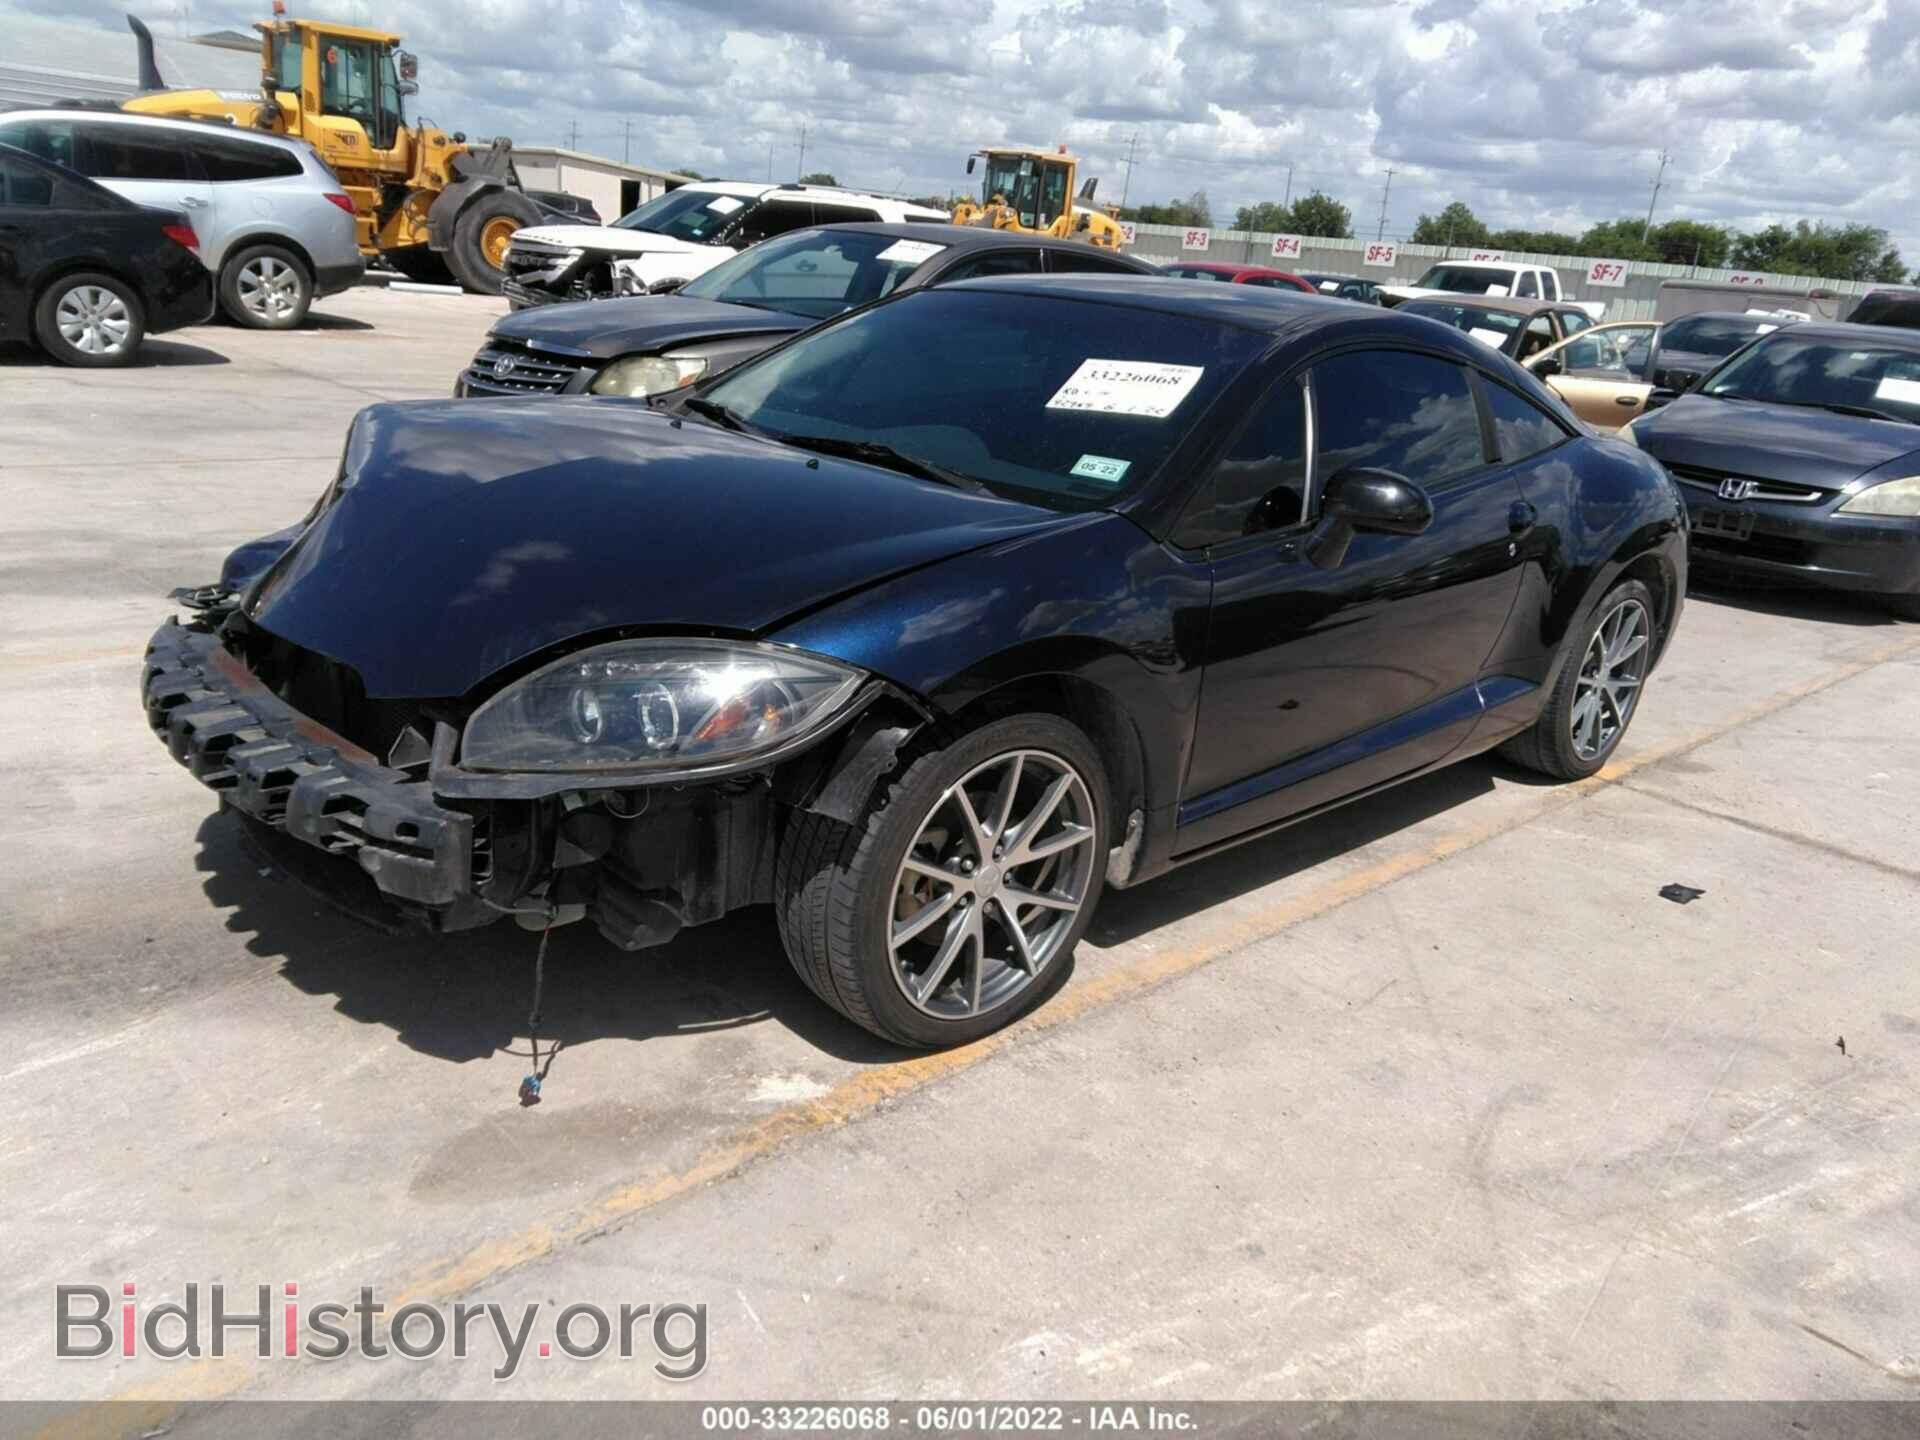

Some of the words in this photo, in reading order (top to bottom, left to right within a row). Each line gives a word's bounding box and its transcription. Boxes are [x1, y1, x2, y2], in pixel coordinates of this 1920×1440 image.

[1186, 231, 1207, 246] SF-3
[1275, 238, 1299, 254] SF-4
[1368, 245, 1394, 262] SF-5
[1591, 263, 1623, 281] SF-7
[1090, 370, 1182, 385] 33226068
